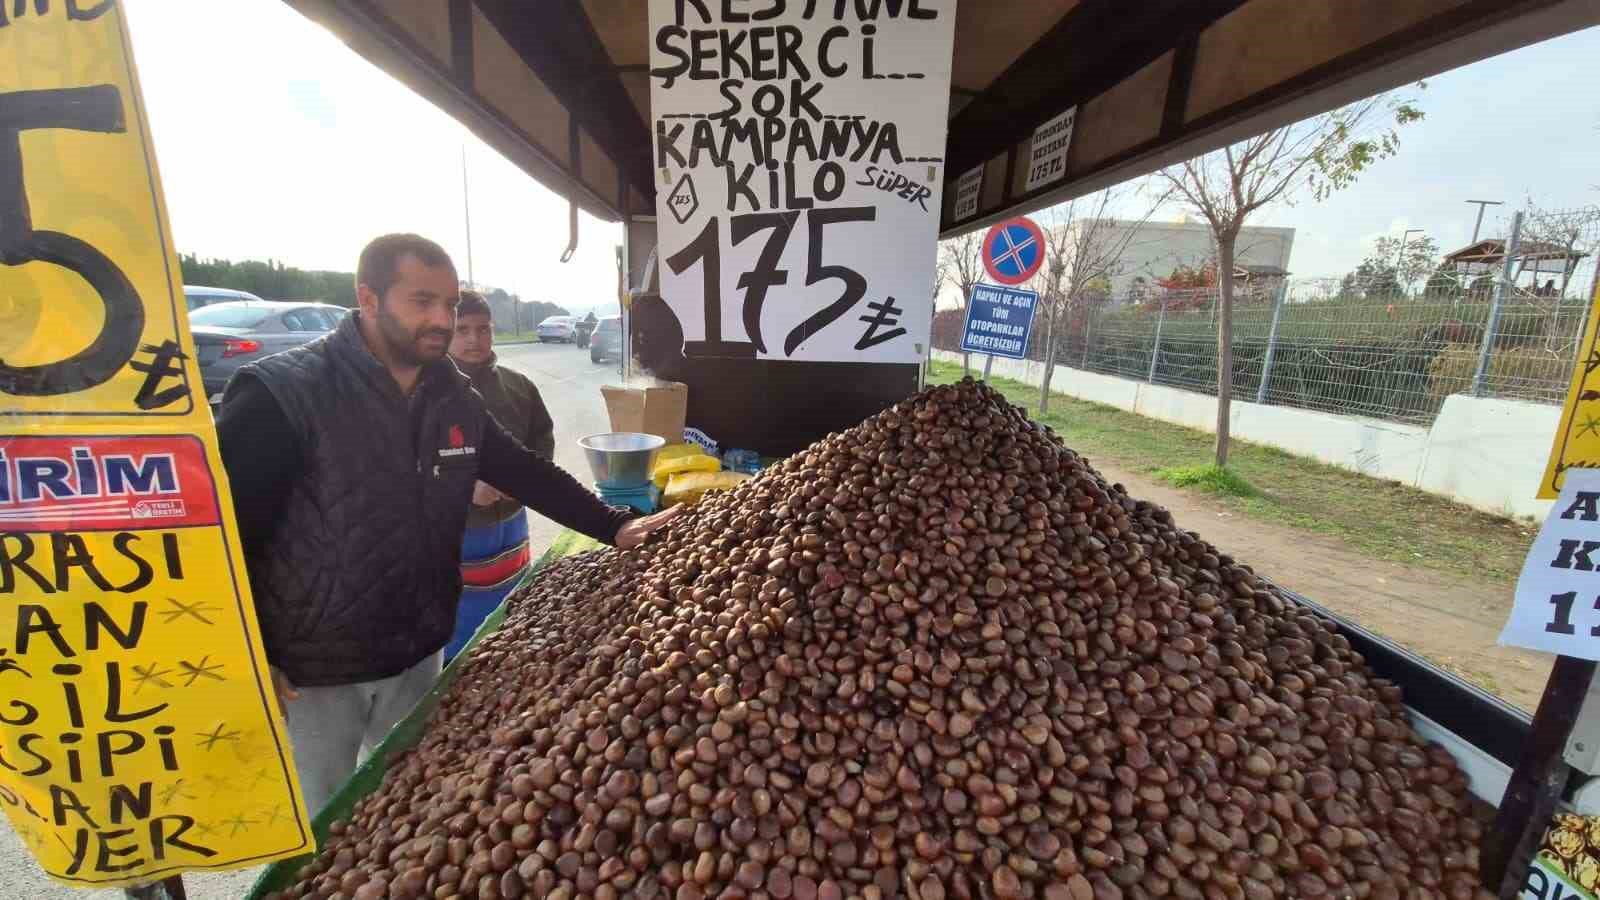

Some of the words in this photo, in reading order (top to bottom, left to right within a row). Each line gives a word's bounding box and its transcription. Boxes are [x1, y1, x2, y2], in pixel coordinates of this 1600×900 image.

[657, 117, 904, 169] KAMPANYA
[855, 166, 932, 213] SÜPER
[665, 206, 877, 357] 175
[1002, 294, 1013, 305] VE
[970, 320, 1024, 336] OTOPARKLAR
[1550, 538, 1600, 572] K
[0, 601, 148, 657] AN
[1545, 592, 1600, 637] 1
[0, 725, 179, 782] SİPİ
[56, 814, 216, 875] YER
